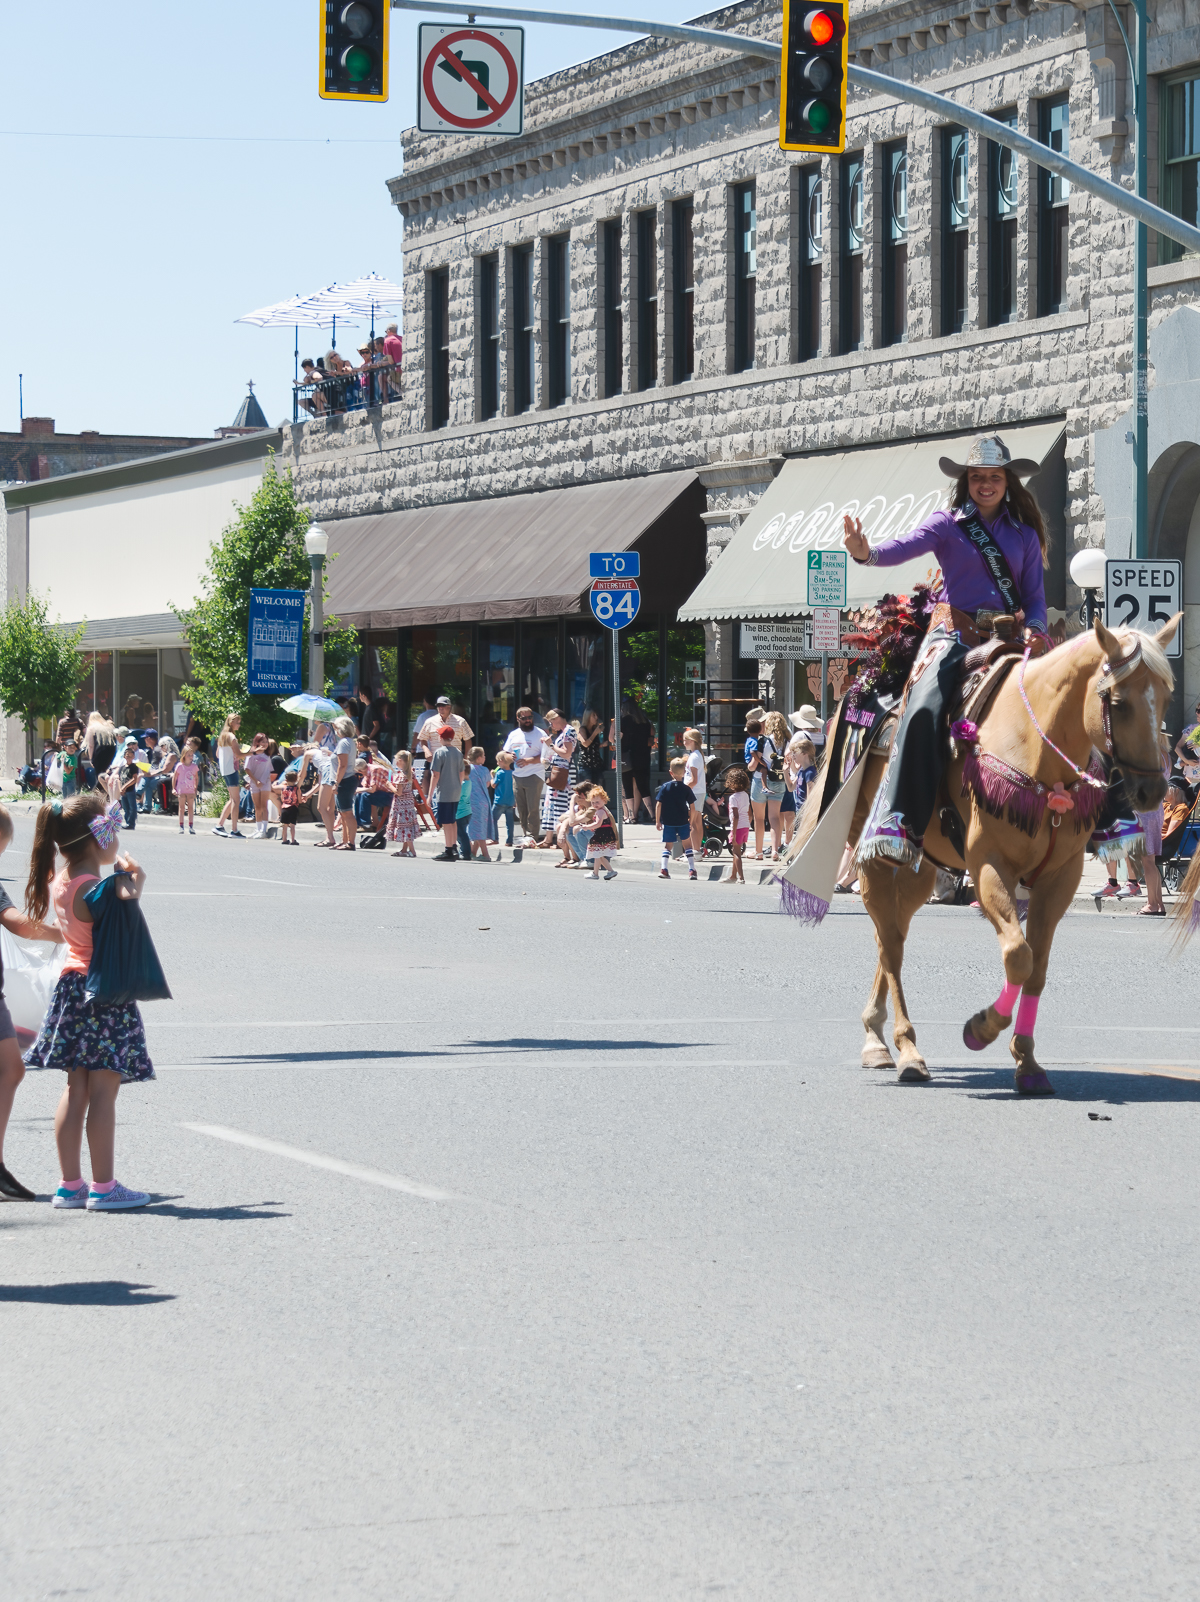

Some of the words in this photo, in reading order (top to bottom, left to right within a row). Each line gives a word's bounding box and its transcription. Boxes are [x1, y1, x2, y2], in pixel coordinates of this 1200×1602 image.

[602, 557, 626, 572] TO
[810, 552, 819, 568] 2
[981, 546, 1002, 577] Senior
[1111, 568, 1175, 588] SPEED
[597, 581, 633, 589] INTERSTATE
[997, 578, 1017, 609] Queen
[255, 595, 302, 607] WELCOME
[595, 591, 635, 620] 84
[1113, 593, 1172, 628] 25
[744, 624, 757, 632] The
[757, 624, 775, 633] BEST
[775, 625, 791, 633] little
[752, 634, 770, 643] wine,
[770, 635, 803, 643] chocolate
[754, 644, 771, 653] good
[772, 644, 789, 652] food
[257, 672, 292, 682] HISTORIC
[252, 680, 279, 689] BAKER
[279, 682, 298, 690] CITY
